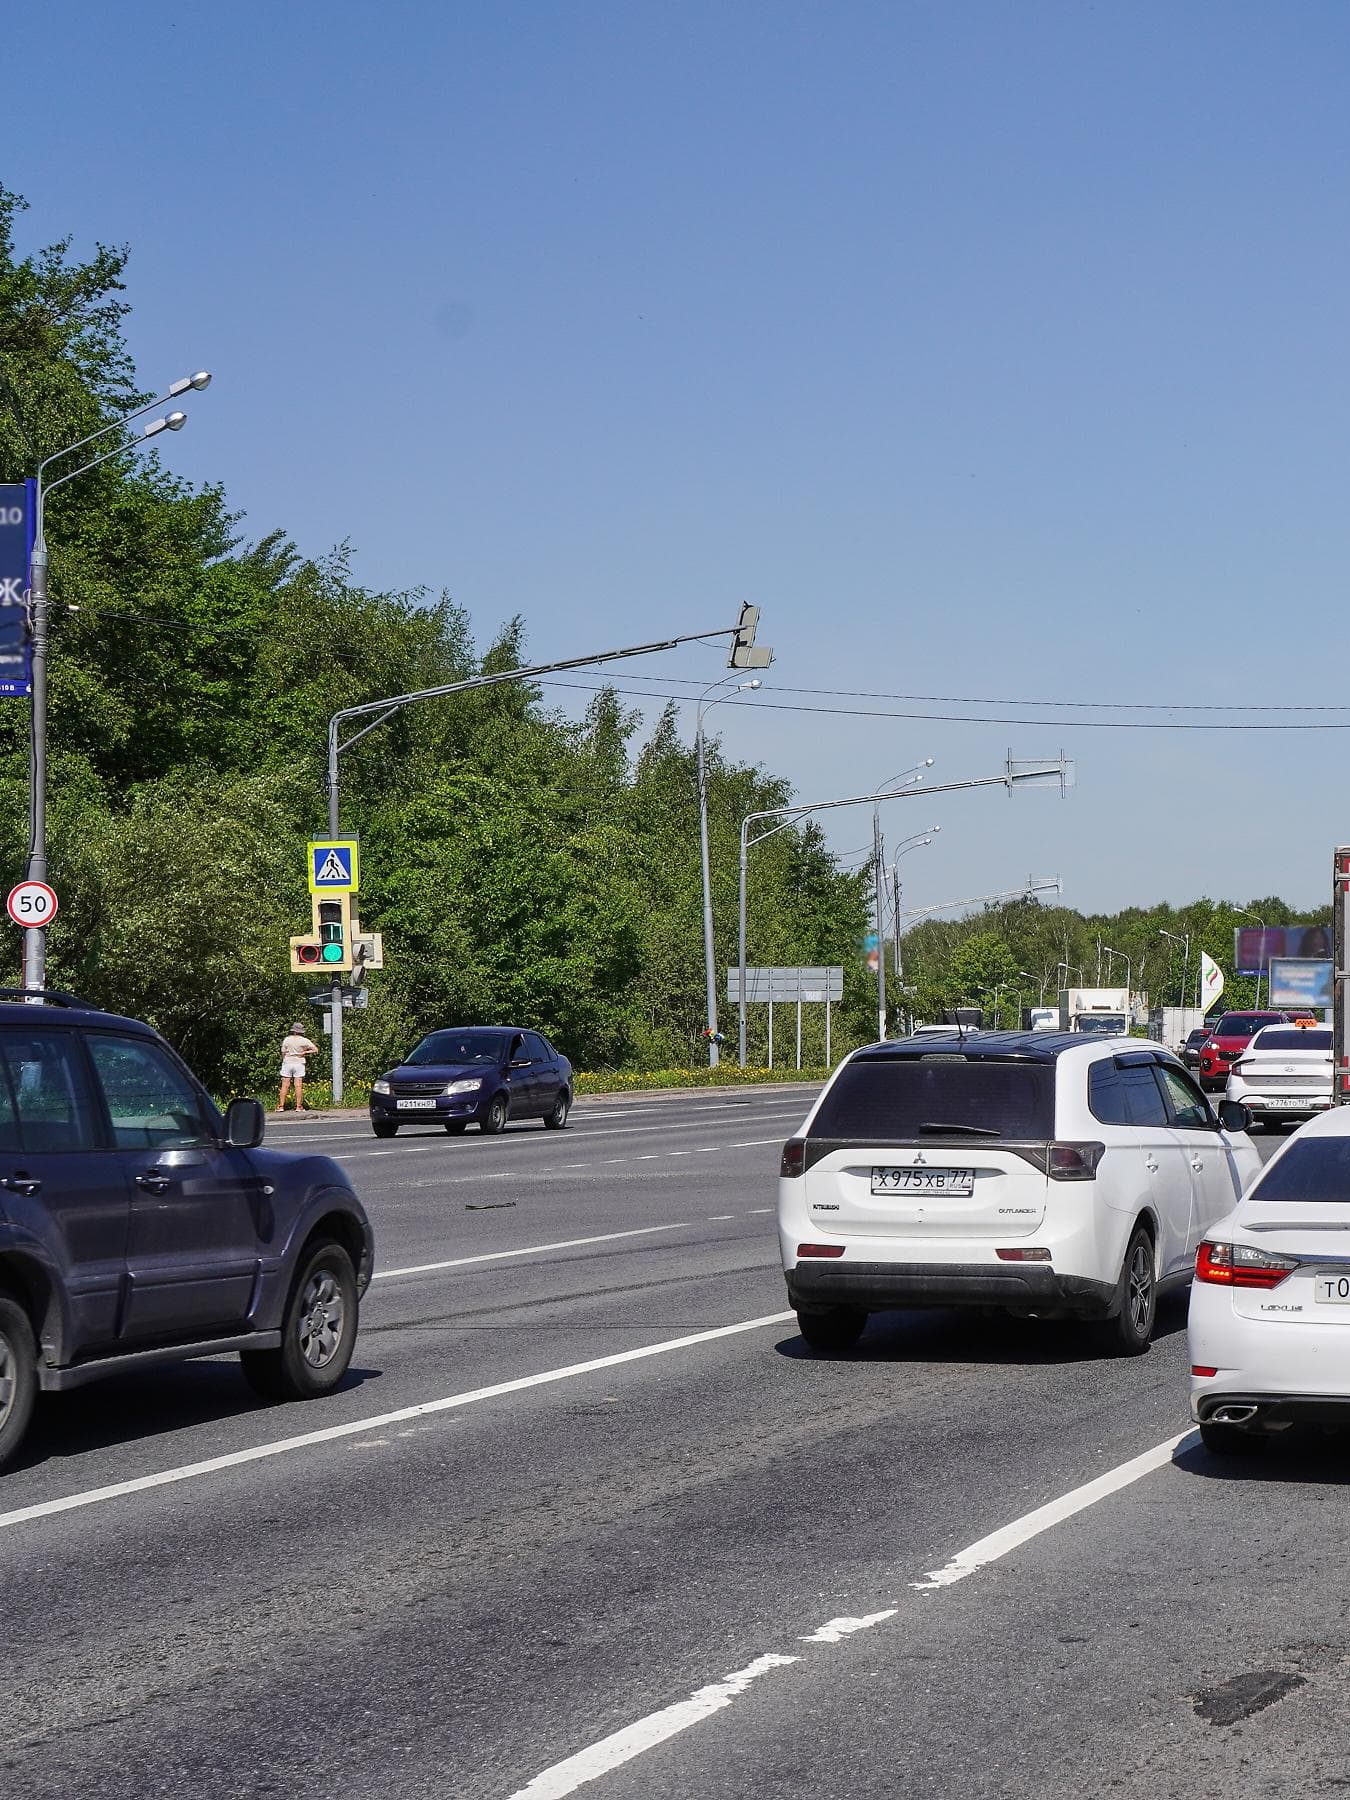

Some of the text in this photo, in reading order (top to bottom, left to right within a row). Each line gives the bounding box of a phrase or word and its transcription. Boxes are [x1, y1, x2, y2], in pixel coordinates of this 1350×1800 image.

[20, 895, 47, 913] 50
[951, 1171, 968, 1184] 77
[1260, 1304, 1304, 1312] LEXUS
